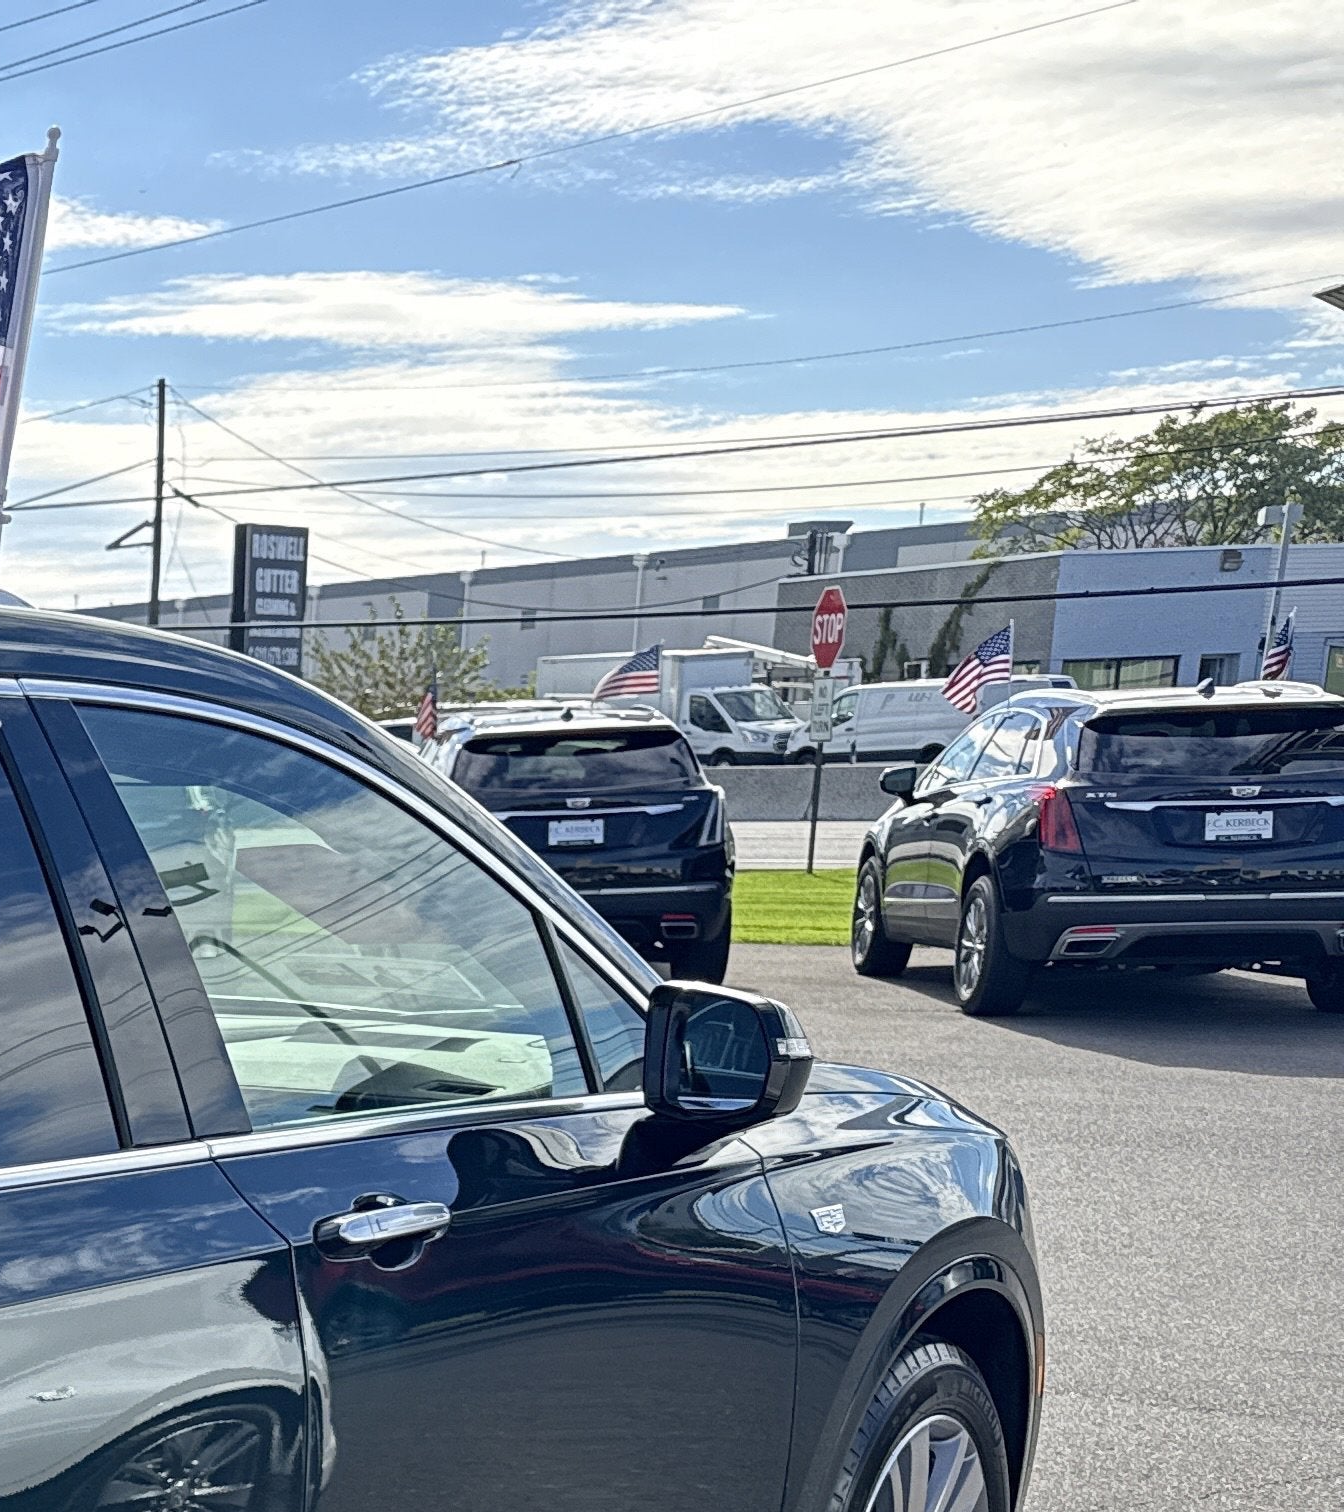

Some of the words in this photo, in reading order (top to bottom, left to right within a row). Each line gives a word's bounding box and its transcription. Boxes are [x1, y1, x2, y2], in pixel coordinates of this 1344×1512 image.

[252, 533, 305, 561] ROSWELL
[255, 567, 299, 594] GUTTER
[813, 612, 844, 645] STOP
[1225, 817, 1271, 828] KERBECK
